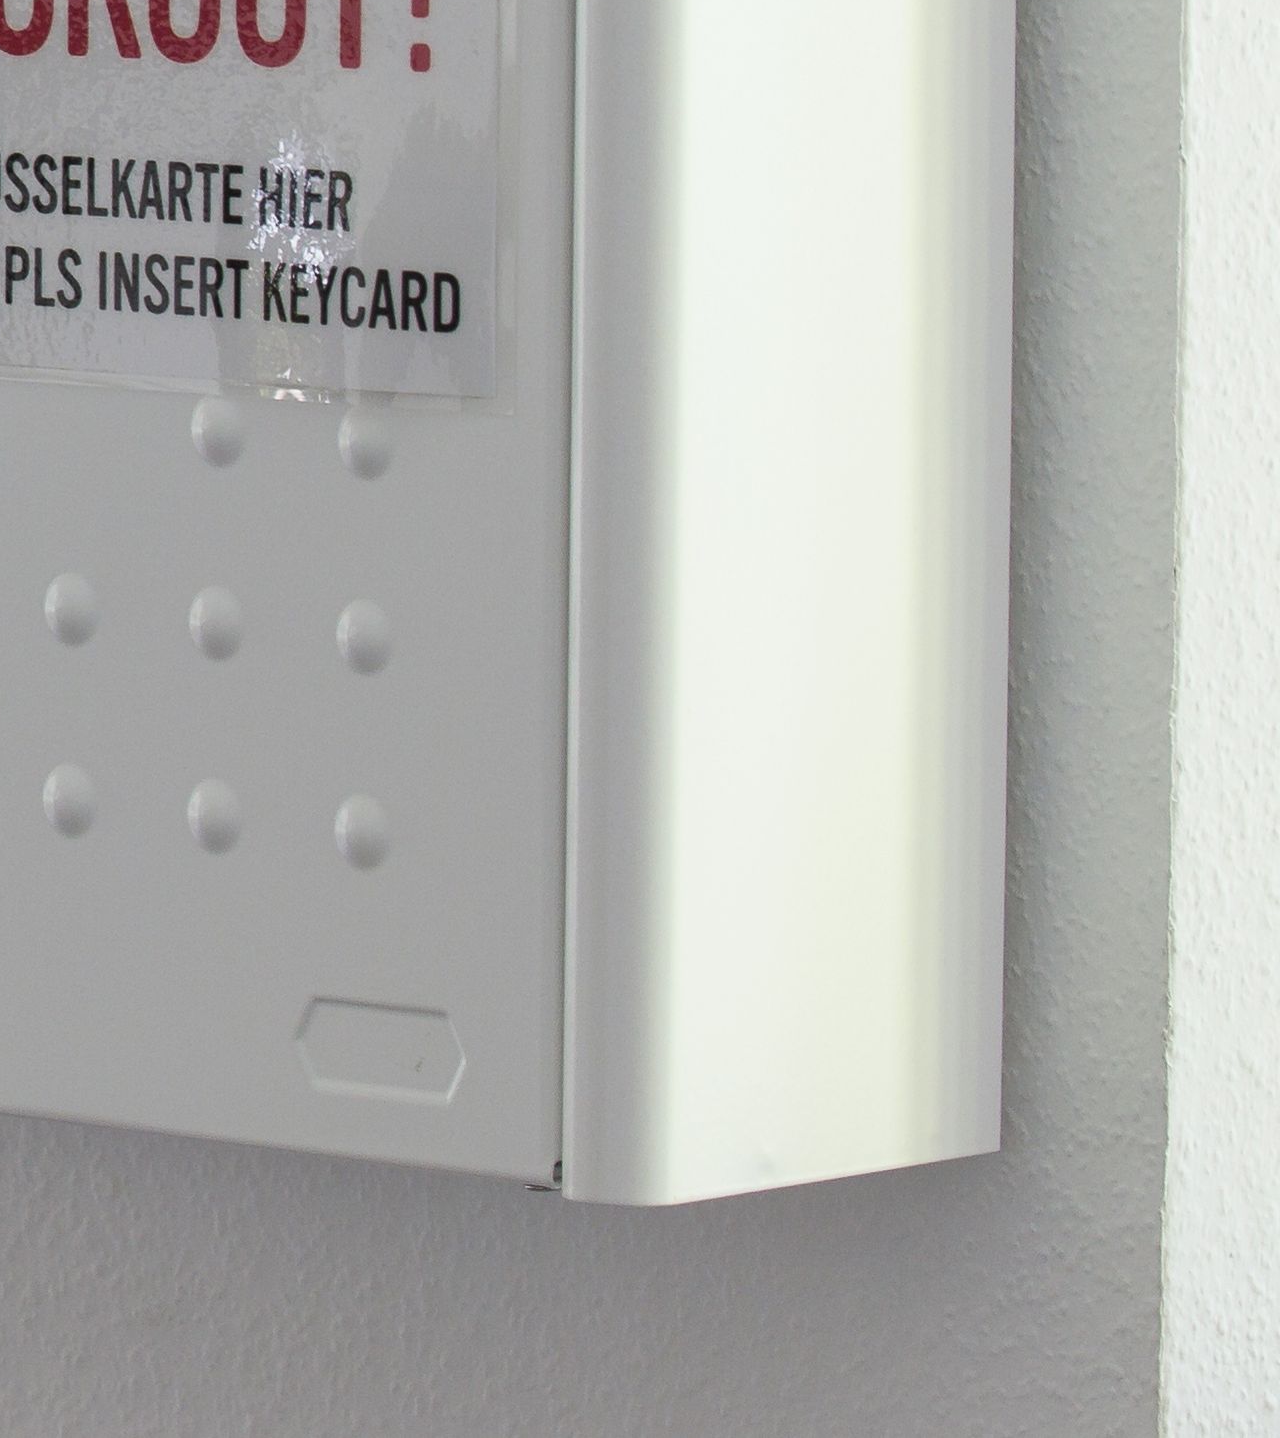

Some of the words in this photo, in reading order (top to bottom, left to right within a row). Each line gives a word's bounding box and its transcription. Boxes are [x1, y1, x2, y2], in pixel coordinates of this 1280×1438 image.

[258, 166, 354, 233] HIER
[5, 246, 83, 310] PLS
[98, 250, 250, 319] INSERT
[262, 262, 462, 334] KEYCARD
